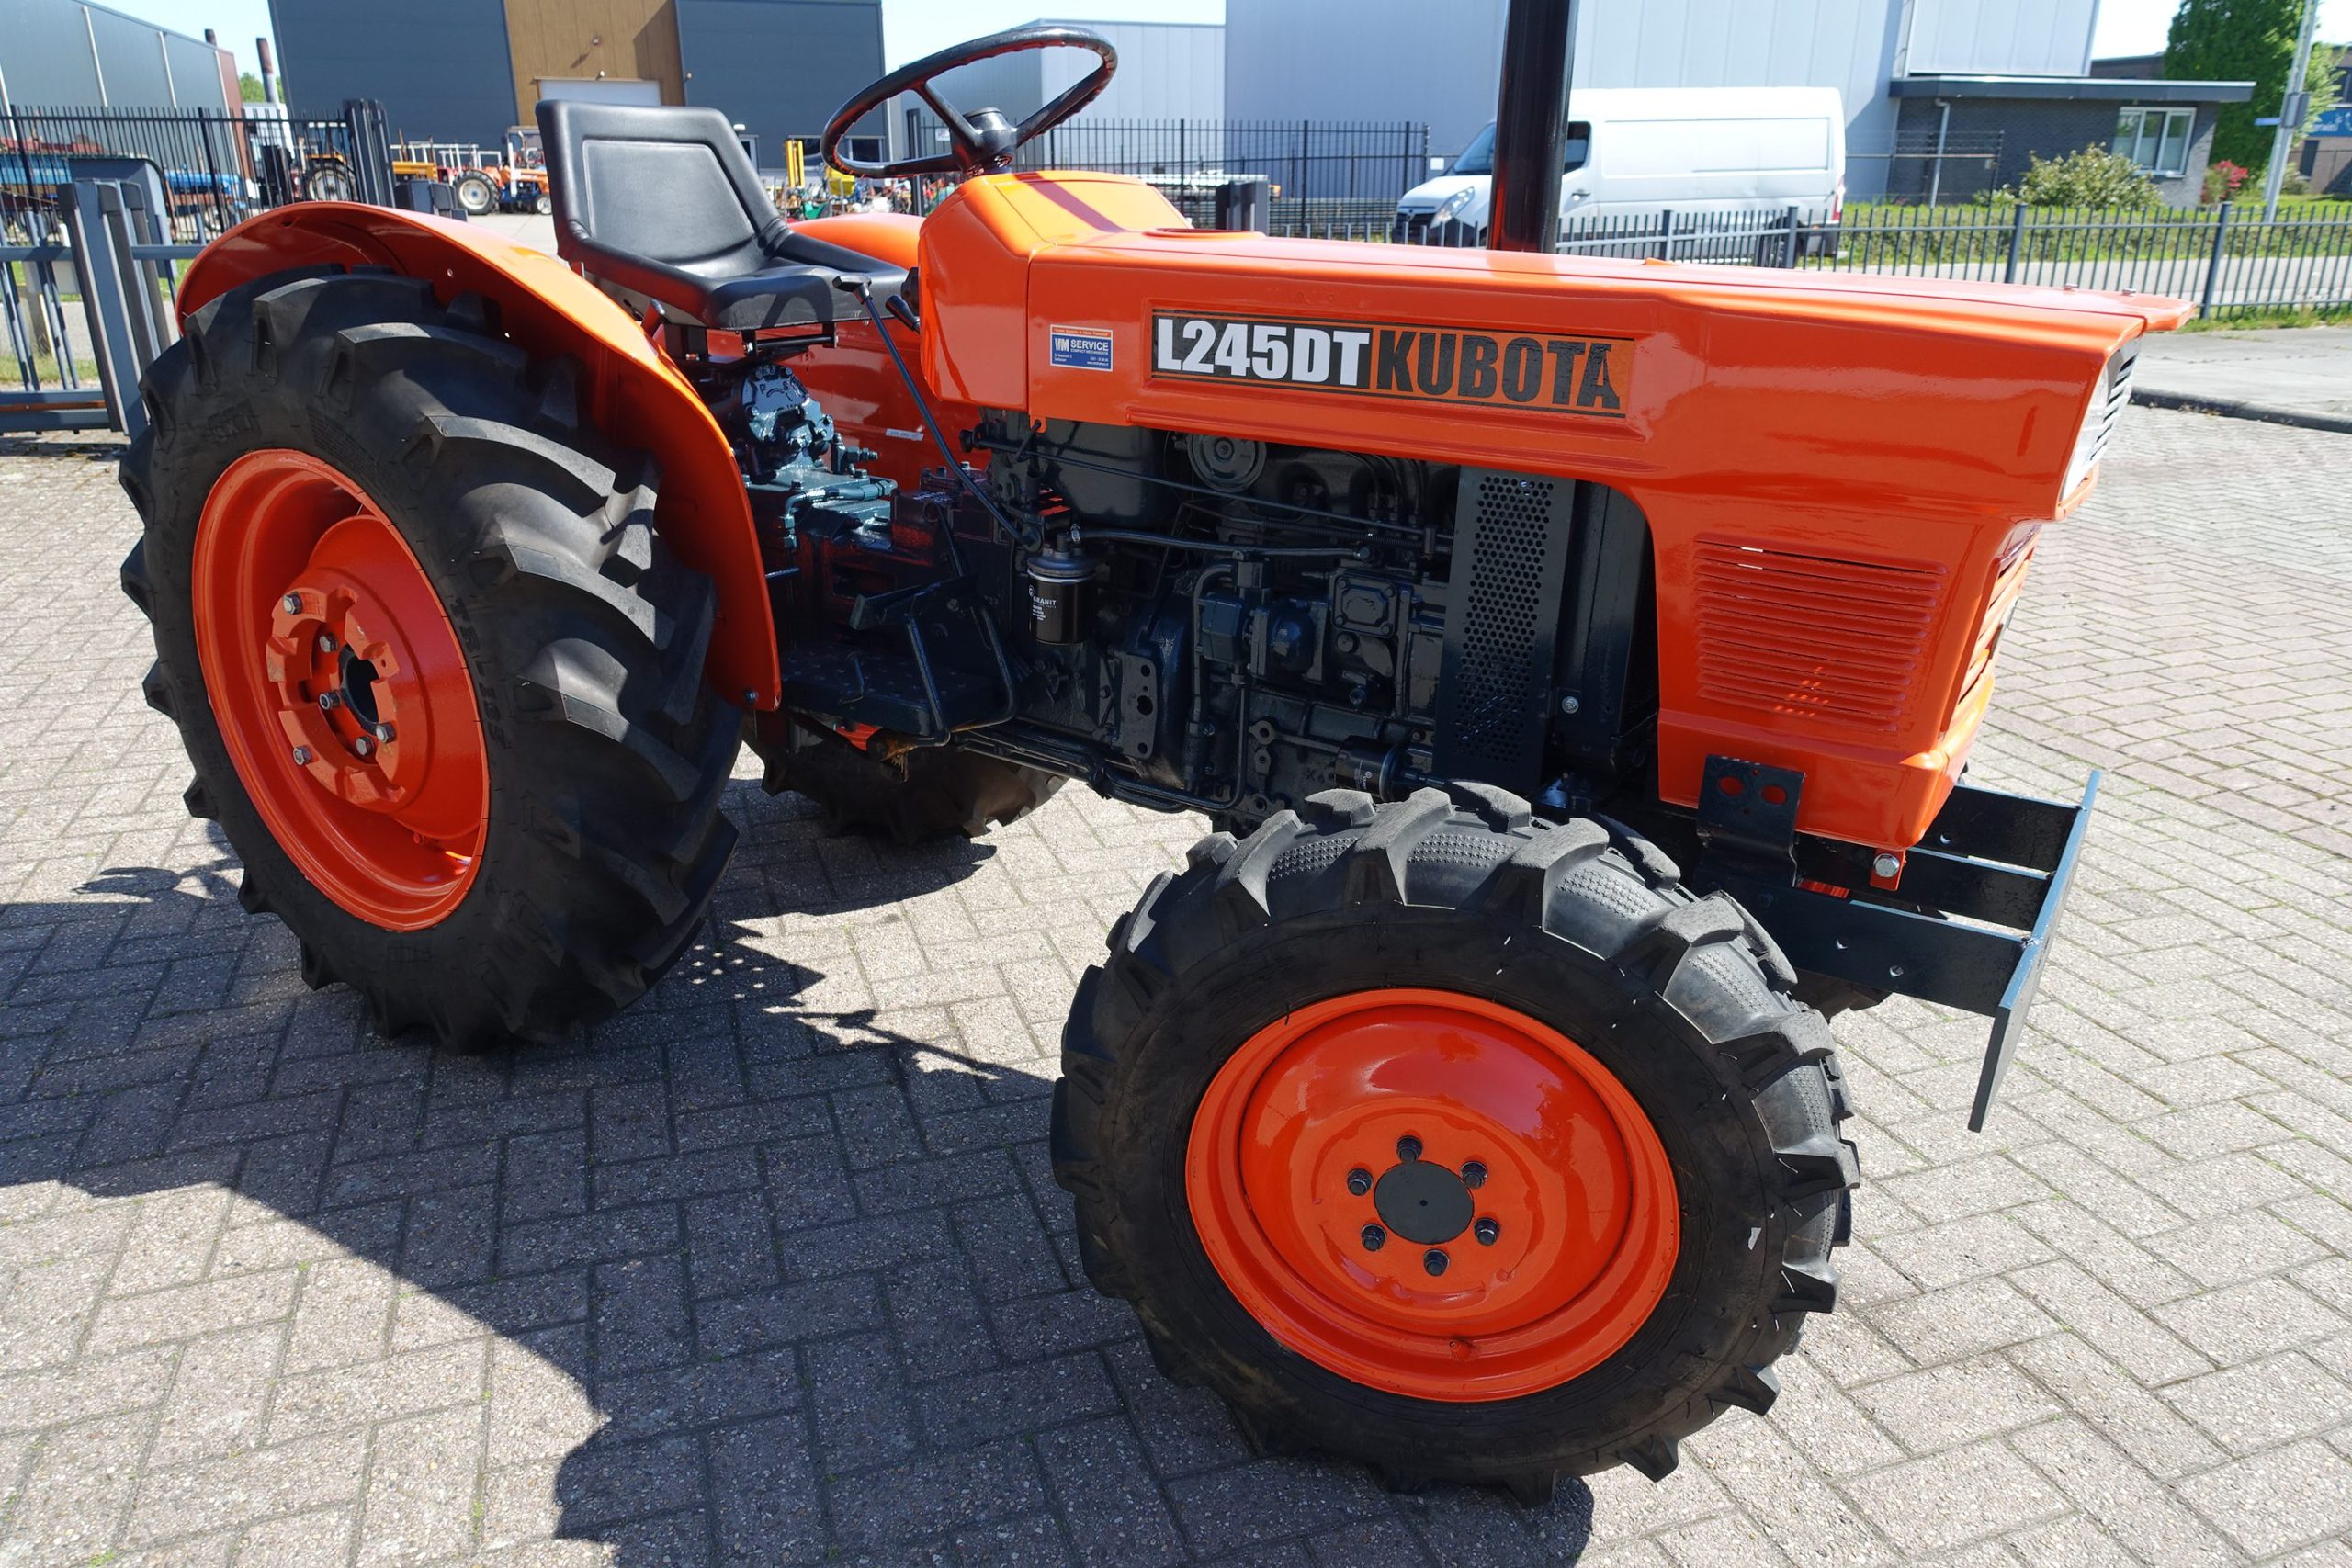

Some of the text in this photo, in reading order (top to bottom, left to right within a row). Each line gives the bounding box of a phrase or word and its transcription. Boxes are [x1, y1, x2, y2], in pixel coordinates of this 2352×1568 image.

[1070, 339, 1109, 351] SERVICE
[1158, 319, 1620, 409] L245DT KUBOTA
[1033, 596, 1057, 605] GRANIT
